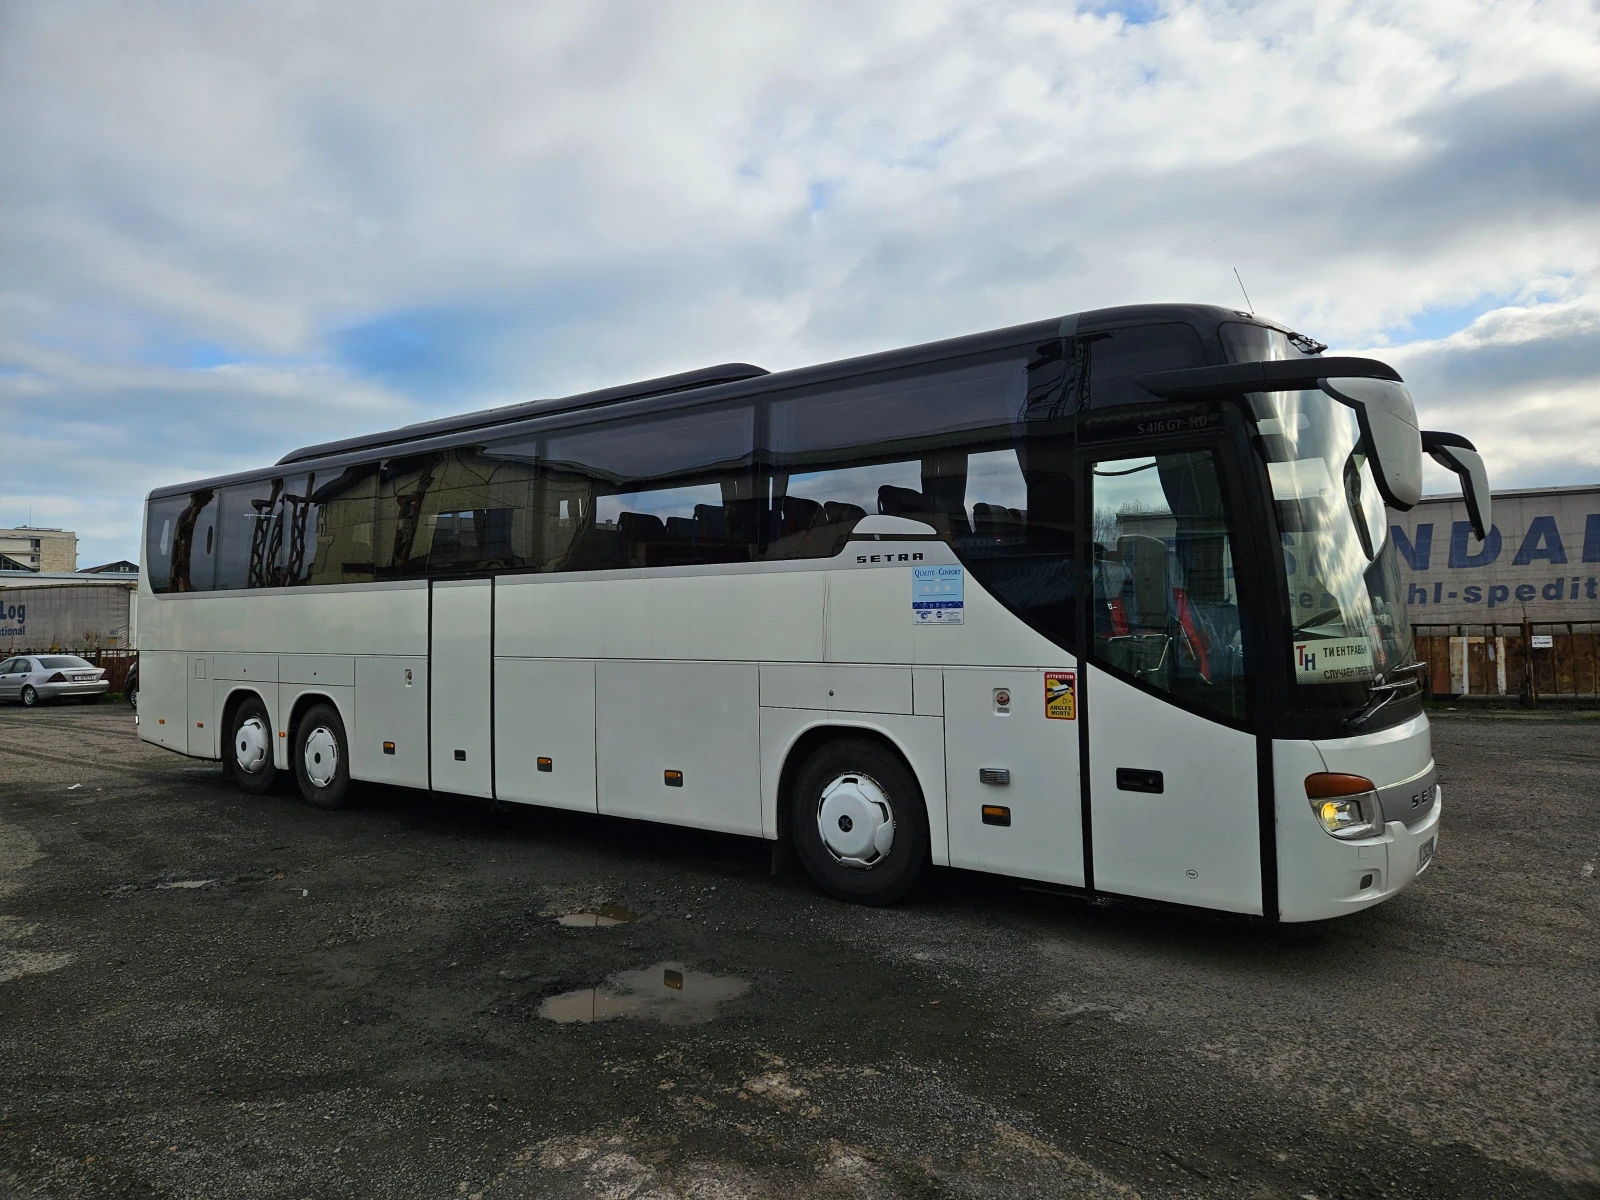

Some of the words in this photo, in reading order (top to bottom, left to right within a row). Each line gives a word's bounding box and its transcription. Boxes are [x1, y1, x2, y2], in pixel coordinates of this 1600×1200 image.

[1146, 421, 1165, 433] 416
[856, 553, 923, 564] SETRA
[1323, 647, 1334, 657] ТИ
[1336, 646, 1346, 656] ЕН
[1323, 667, 1355, 680] СЛУЧАЕН
